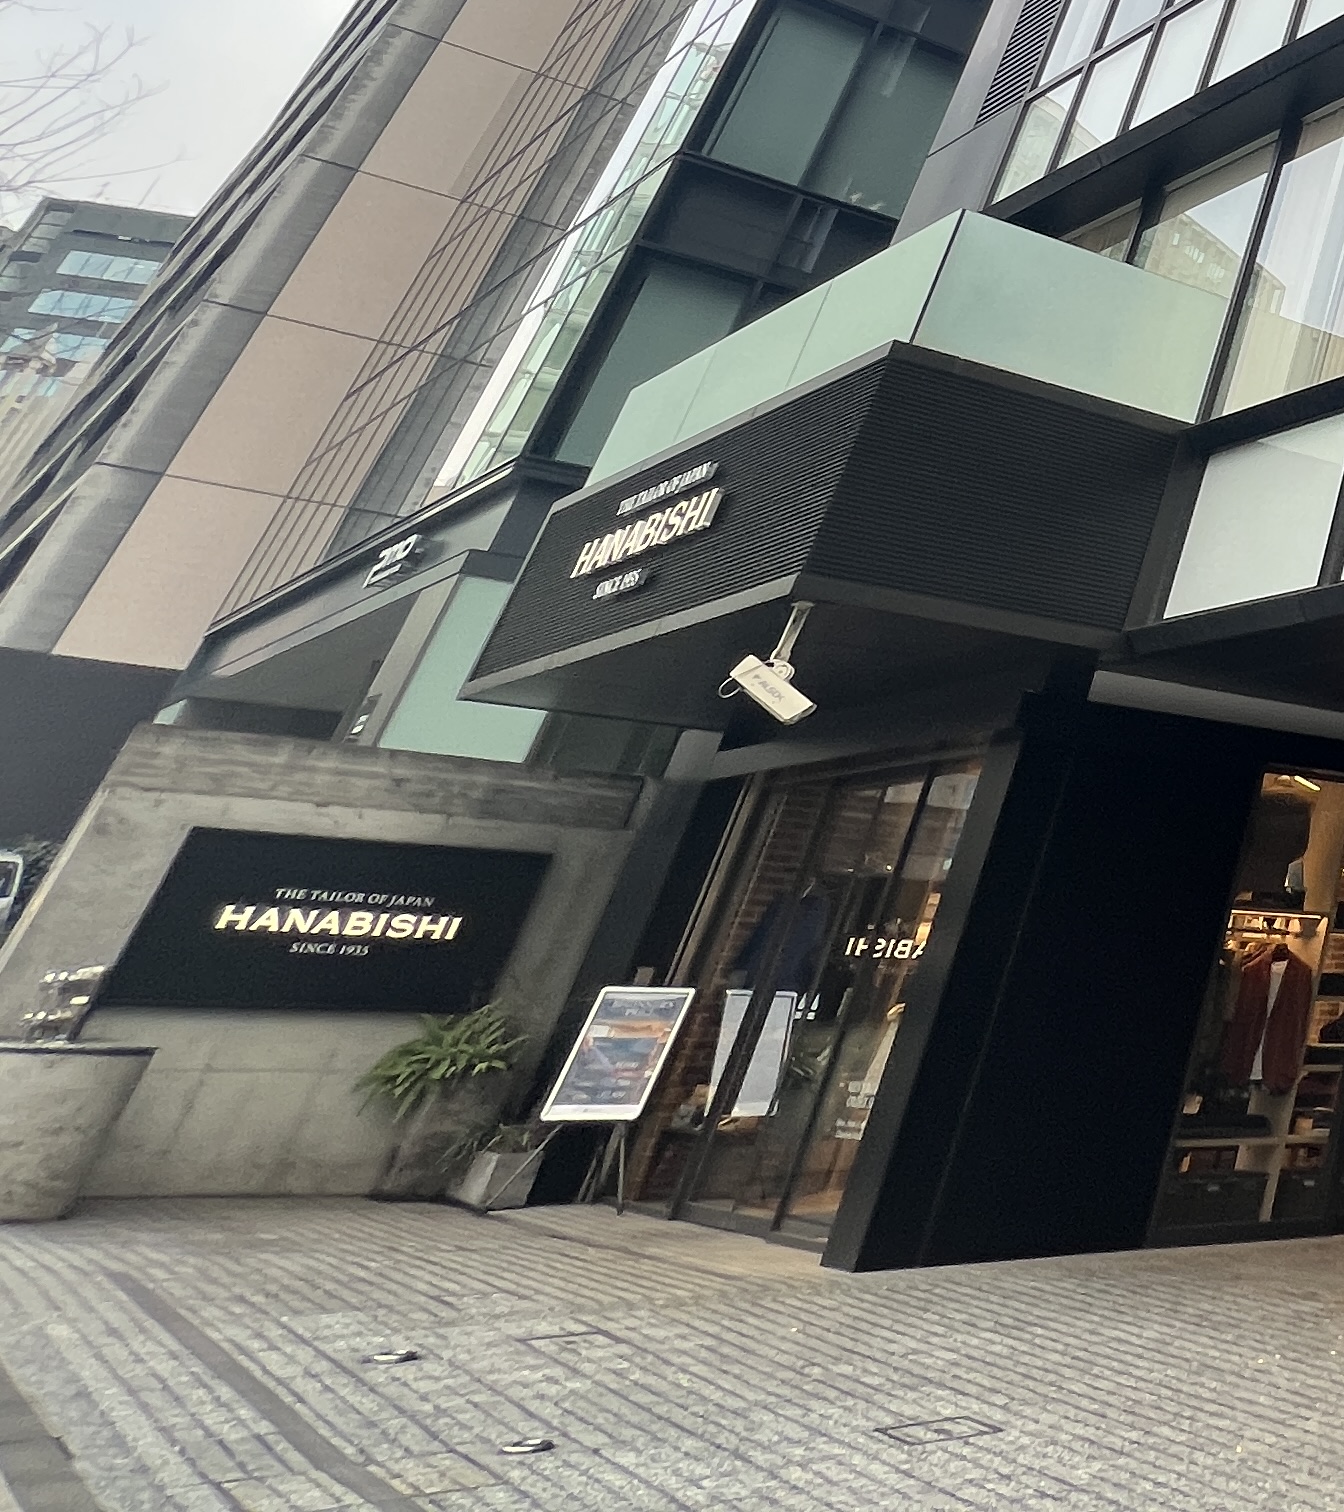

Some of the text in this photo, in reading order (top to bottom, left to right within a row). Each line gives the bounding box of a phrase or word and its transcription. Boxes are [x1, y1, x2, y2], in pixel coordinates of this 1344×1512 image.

[570, 487, 722, 579] HANABISHI
[275, 887, 435, 908] THE TAILOR OF JAPAN
[214, 903, 463, 940] HANABISHI
[289, 941, 336, 955] SINCE
